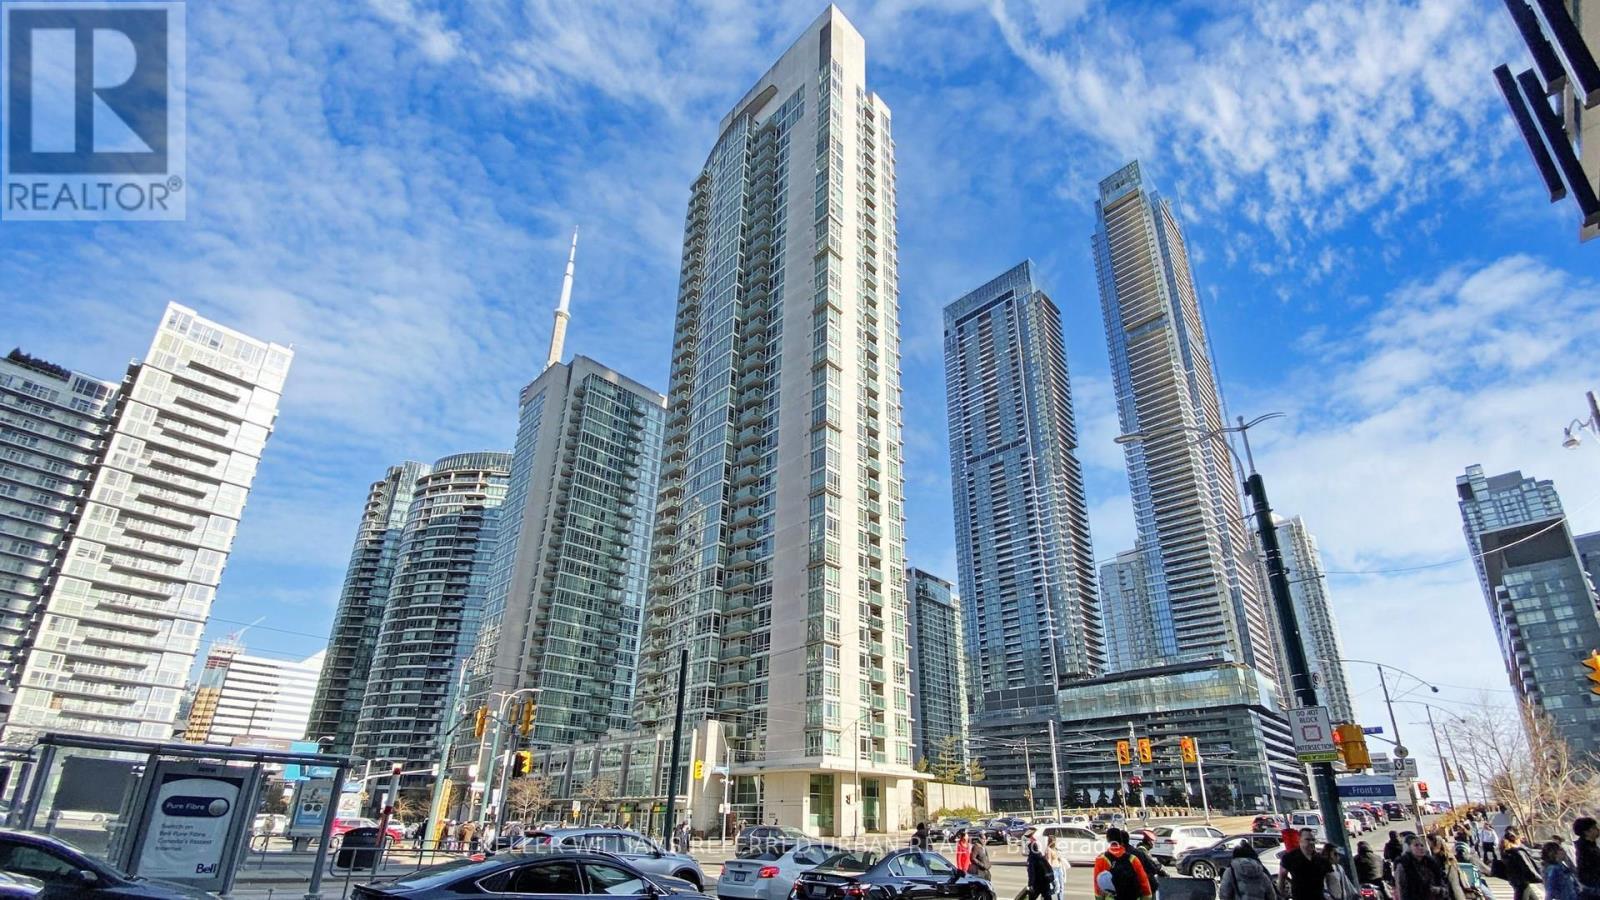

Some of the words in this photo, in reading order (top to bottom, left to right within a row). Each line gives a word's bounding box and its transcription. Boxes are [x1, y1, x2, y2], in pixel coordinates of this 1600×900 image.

[1296, 743, 1334, 751] INTERSECTION
[1351, 786, 1374, 795] Front
[166, 801, 185, 809] Pure
[185, 802, 206, 810] Fibre
[195, 863, 218, 874] Bell
